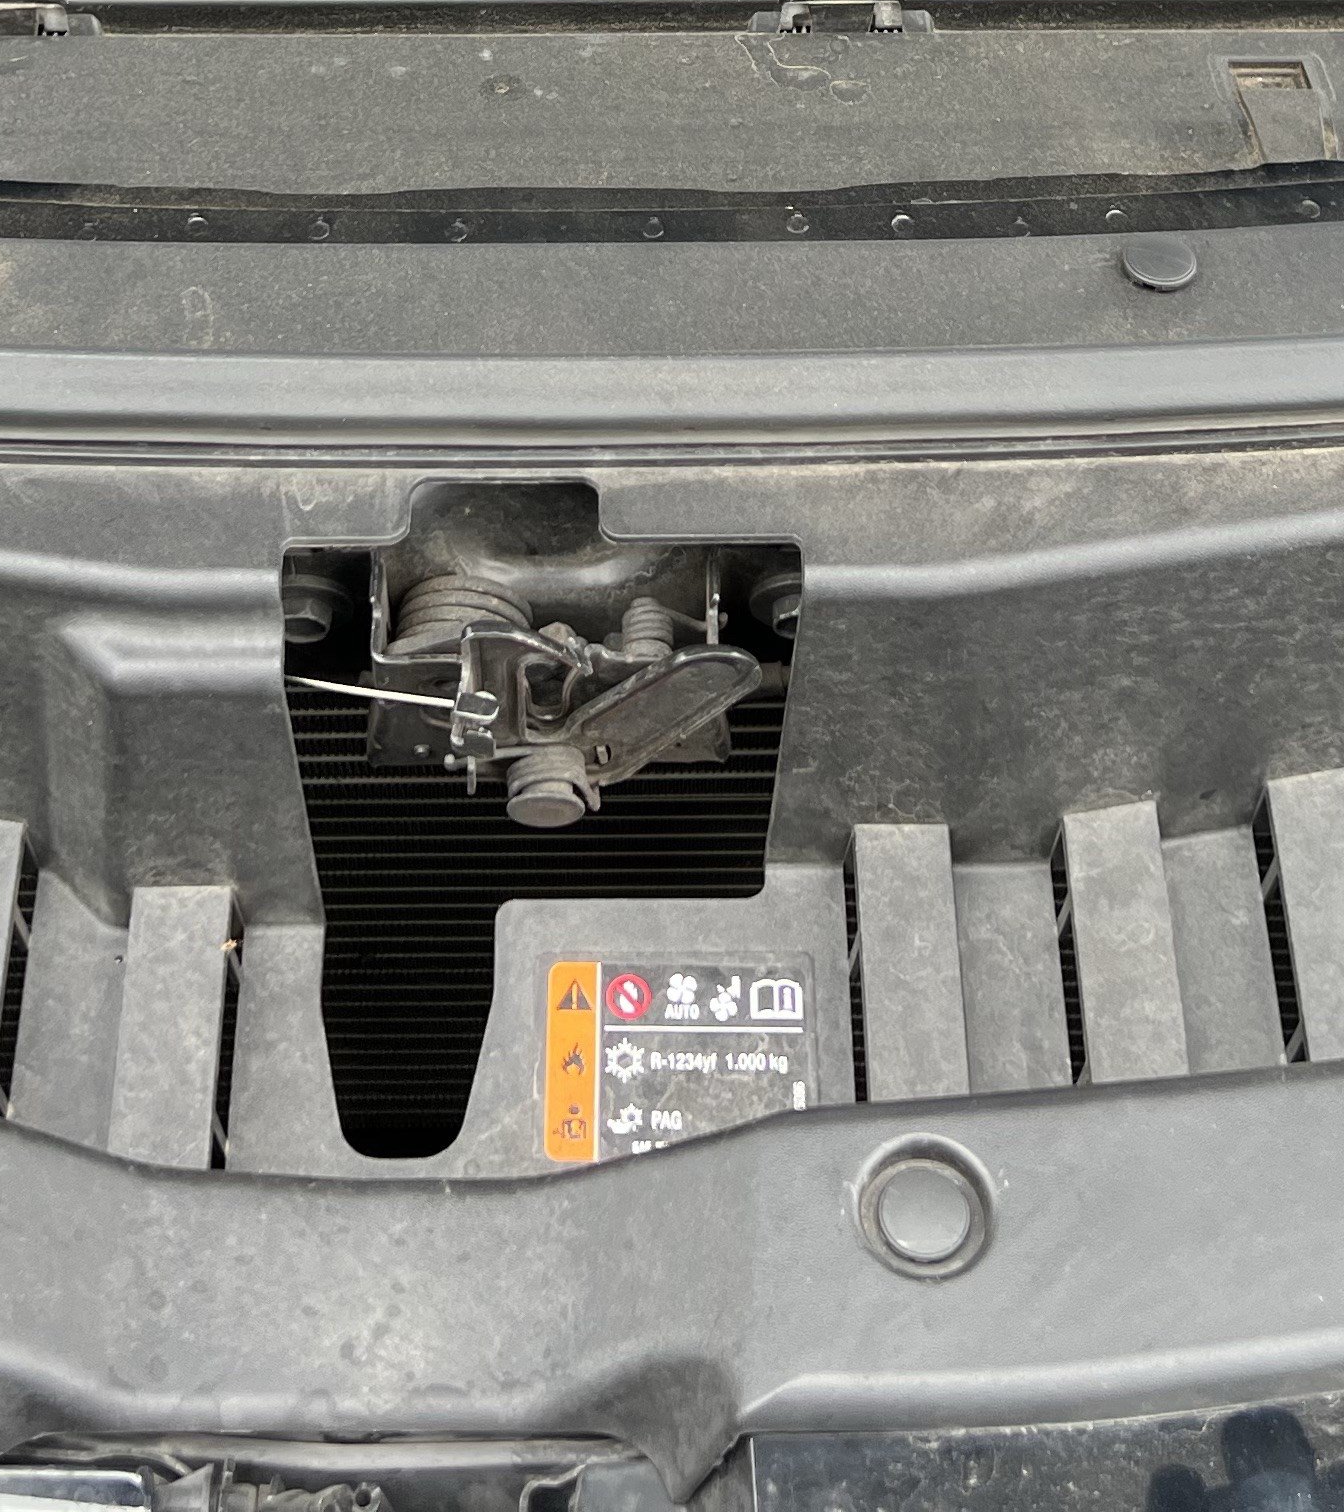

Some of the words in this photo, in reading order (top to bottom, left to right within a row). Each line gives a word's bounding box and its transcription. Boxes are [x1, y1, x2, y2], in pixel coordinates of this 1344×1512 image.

[664, 1003, 700, 1020] AUTO
[650, 1051, 718, 1074] R-1234yf
[725, 1052, 766, 1072] 1.000
[768, 1052, 789, 1075] kg
[650, 1110, 683, 1131] PAG
